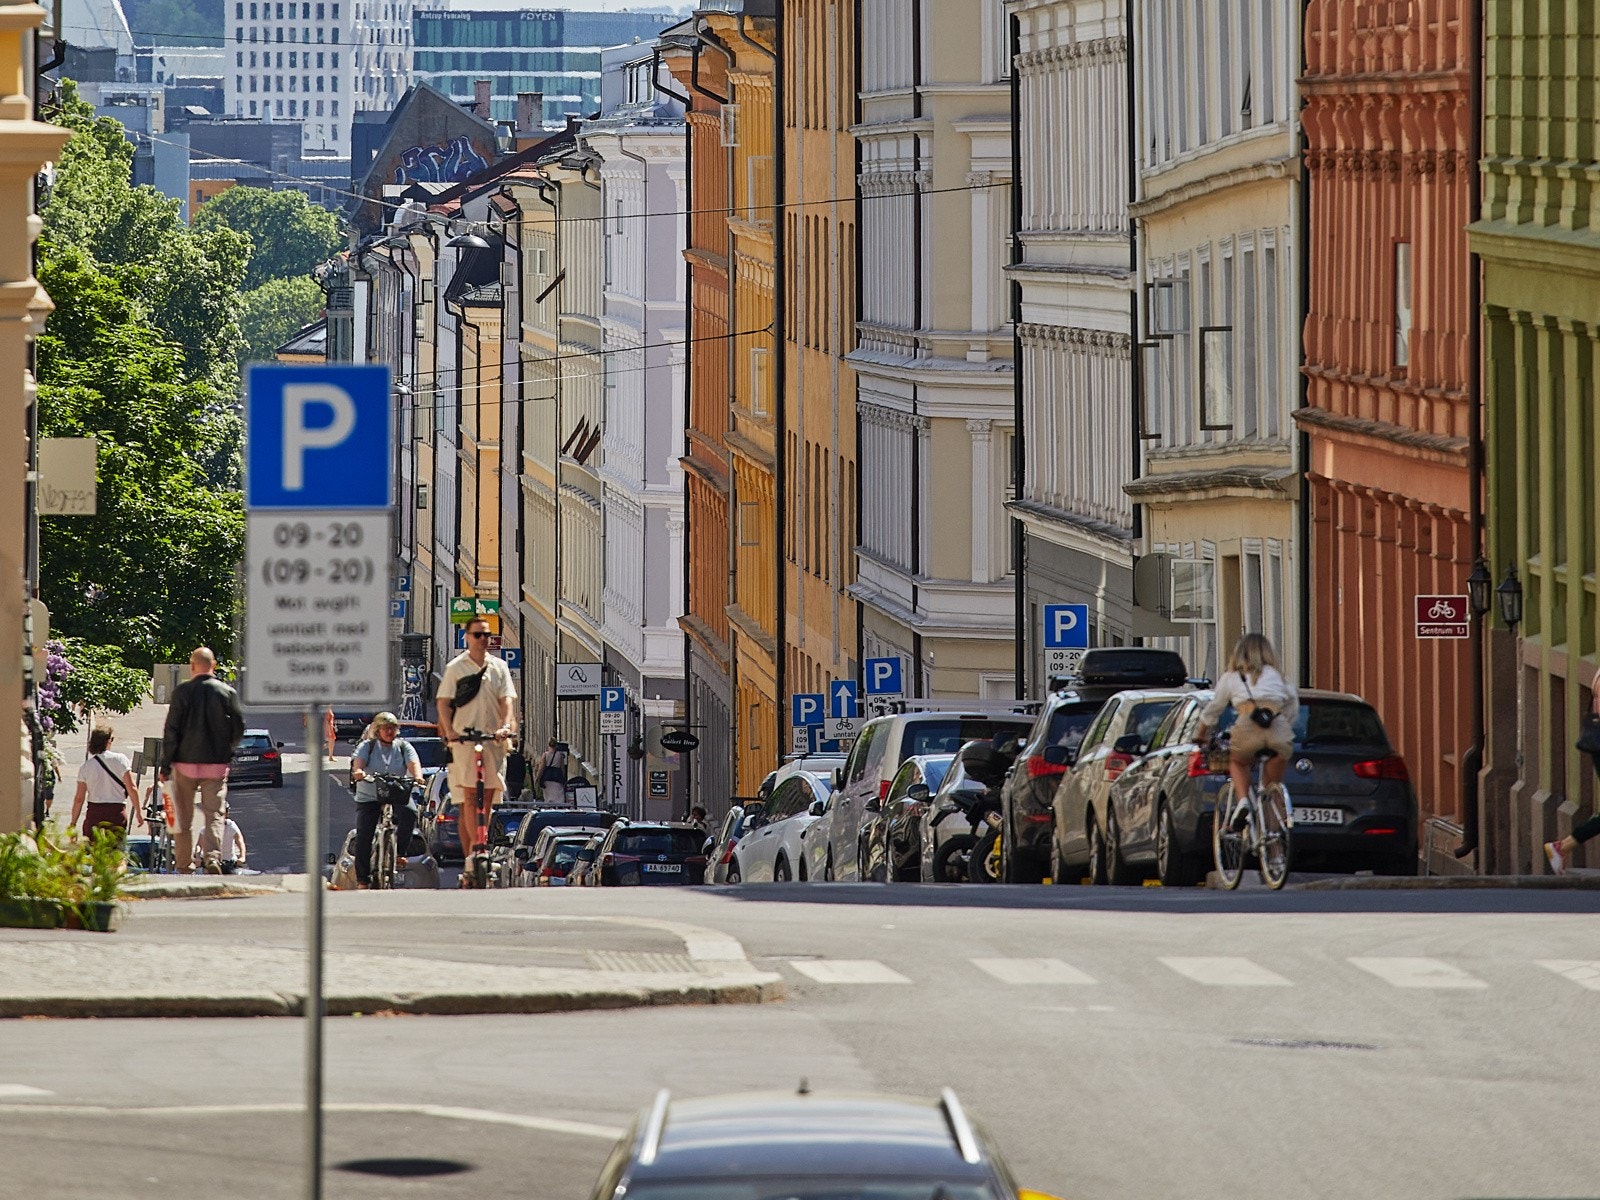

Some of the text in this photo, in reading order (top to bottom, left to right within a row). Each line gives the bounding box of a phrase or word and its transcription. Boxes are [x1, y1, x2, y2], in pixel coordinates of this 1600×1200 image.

[282, 383, 357, 492] P
[1054, 610, 1078, 643] P
[1420, 626, 1453, 635] Sentrum
[505, 650, 516, 665] P
[1052, 652, 1080, 660] 09-20
[874, 662, 893, 690] P
[1049, 662, 1075, 672] (09-2
[606, 690, 619, 709] P
[800, 698, 817, 723] P
[613, 735, 623, 799] LLERI
[1302, 809, 1339, 822] 35194
